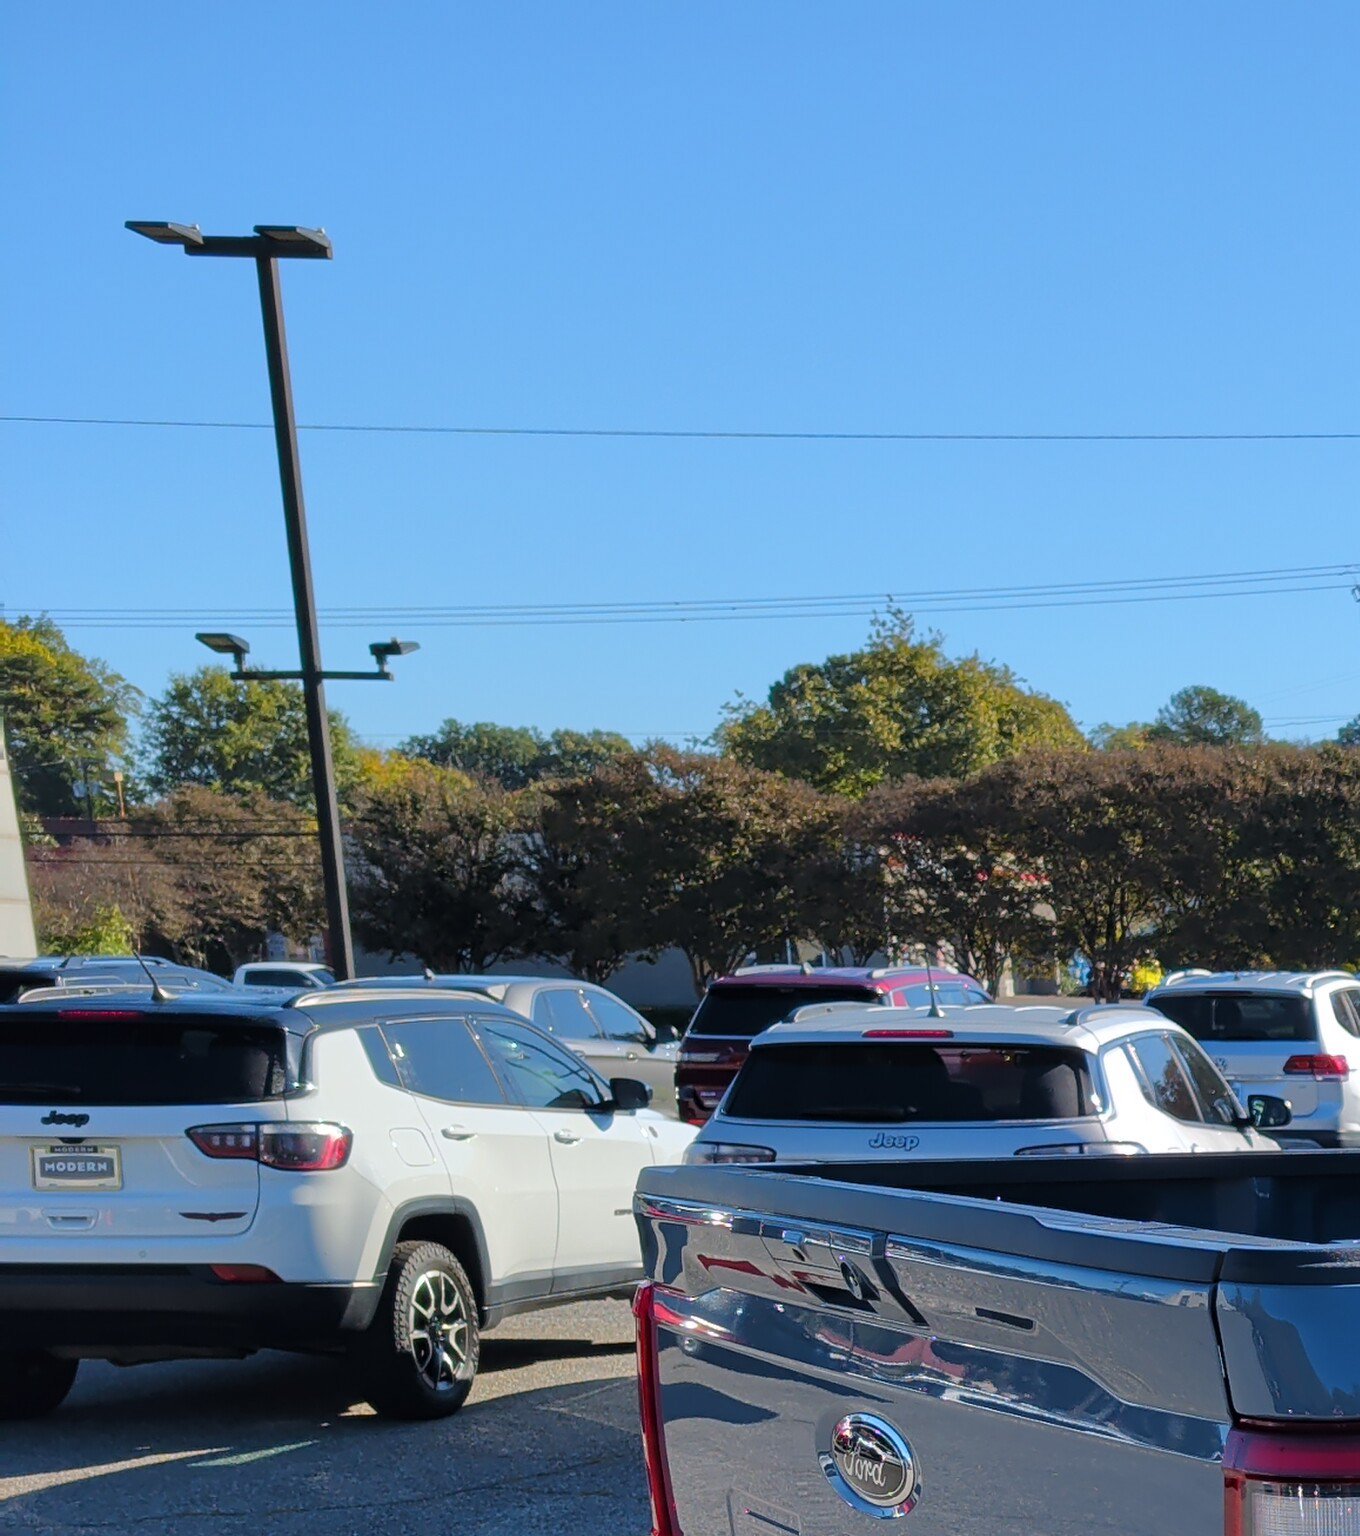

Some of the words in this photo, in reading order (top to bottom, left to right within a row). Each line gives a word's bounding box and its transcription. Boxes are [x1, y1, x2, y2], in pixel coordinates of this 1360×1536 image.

[41, 1110, 90, 1128] Jeep
[868, 1132, 920, 1151] Jeep
[44, 1161, 107, 1172] MODERN
[843, 1439, 887, 1488] Ford
